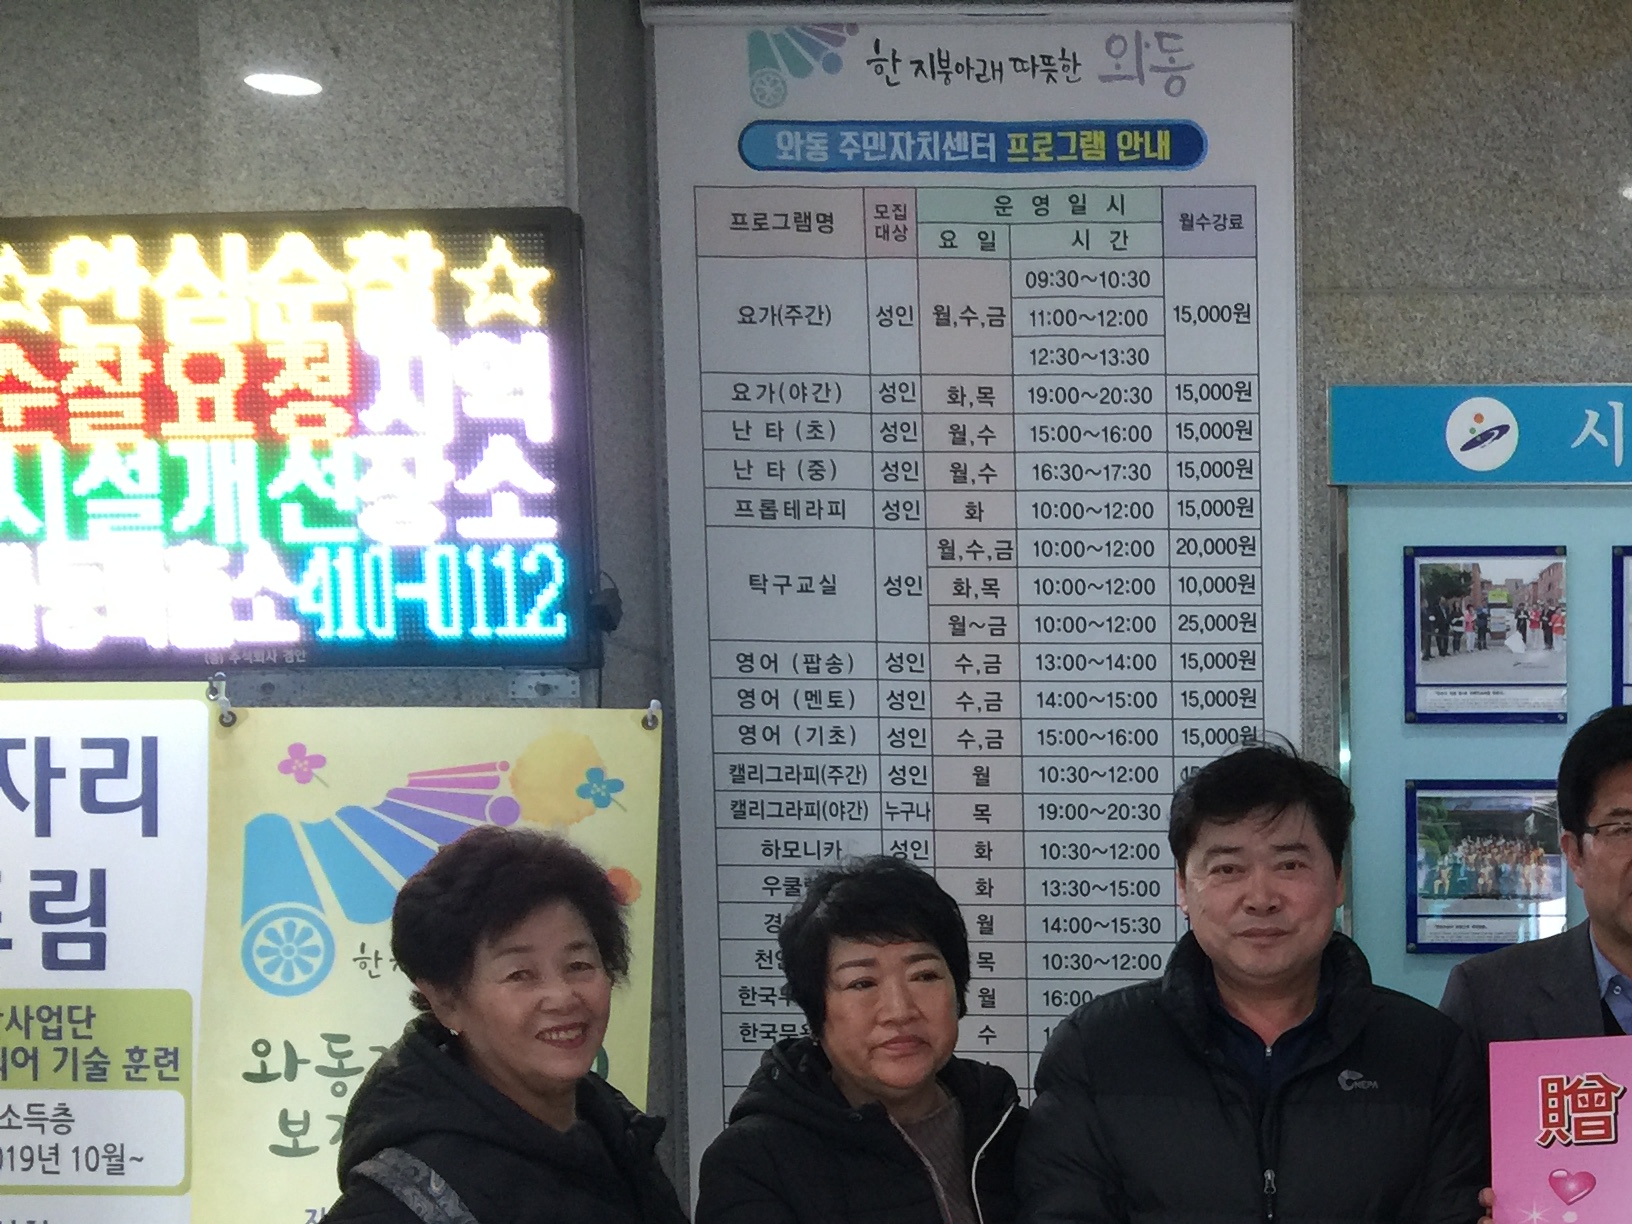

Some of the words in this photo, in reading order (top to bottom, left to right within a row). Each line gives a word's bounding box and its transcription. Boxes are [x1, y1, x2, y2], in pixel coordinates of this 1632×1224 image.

[865, 37, 903, 87] 한
[909, 55, 1004, 86] 지붕아래
[1008, 46, 1082, 85] 따뜻한
[776, 130, 829, 162] 와동
[839, 130, 996, 163] 주민자치센터
[1006, 129, 1106, 163] 프로그램
[1116, 129, 1171, 162] 안내
[729, 211, 834, 235] 프로그램명
[1178, 212, 1245, 232] 월수강료
[873, 203, 907, 222] 모집
[874, 223, 909, 243] 대상
[1025, 269, 1151, 289] 09:30~10:30
[737, 303, 832, 327] 요가(주간)
[875, 304, 914, 328] 성인
[932, 304, 1007, 329] 월,수,금
[1029, 308, 1148, 328] 11:00~12:00
[1173, 302, 1251, 326] 15,000원
[1029, 347, 1150, 367] 12:30~13:30
[731, 381, 842, 405] 요가(야간)
[878, 381, 917, 404] 성인
[946, 385, 996, 409] 화,목
[1027, 386, 1153, 405] 19:00~20:30
[1175, 380, 1253, 404] 15,000원
[879, 420, 918, 444] 성인
[947, 423, 997, 447] 월,수
[1030, 424, 1153, 444] 15:00~16:00
[1175, 419, 1253, 443] 15,000원
[949, 461, 998, 485] 월,수
[1032, 463, 1152, 482] 16:30~17:30
[1176, 457, 1254, 482] 15,000원
[733, 498, 846, 521] 프롭테라피
[964, 500, 985, 523] 화
[1031, 501, 1154, 520] 10:00~12:00
[1177, 496, 1254, 520] 15,000원
[937, 538, 1014, 562] 월,수,금
[1033, 539, 1155, 559] 10:00~12:00
[1175, 535, 1256, 558] 20,000원
[748, 573, 837, 596] 탁구교실
[883, 575, 923, 597] 성인
[952, 577, 1001, 600] 화,목
[1033, 577, 1156, 596] 10:00~12:00
[1178, 573, 1256, 597] 10,000원
[948, 614, 1008, 637] 월~금
[1034, 615, 1157, 634] 10:00~12:00
[1177, 611, 1257, 635] 25,000원
[735, 652, 778, 674] 영어
[792, 652, 854, 675] (팝송)
[954, 653, 1003, 676] 수,금
[1035, 653, 1157, 672] 13:00~14:00
[737, 688, 779, 710] 영어
[793, 688, 855, 711] (멘토)
[955, 690, 1004, 713] 수,금
[1036, 691, 1158, 709] 14:00~15:00
[738, 724, 781, 746] 영어
[794, 724, 856, 747] (기초)
[956, 728, 1004, 751] 수,금
[1037, 728, 1159, 747] 15:00~16:00
[728, 762, 868, 786] 캘리그라피(주간)
[972, 765, 990, 787] 월
[1038, 765, 1159, 784] 10:30~12:00
[730, 798, 869, 822] 캘리그라피(야간)
[884, 801, 932, 823] 누구나
[972, 803, 992, 825] 목
[1037, 802, 1161, 821] 19:00~20:30
[760, 838, 843, 861] 하모니카
[973, 840, 994, 862] 화
[1040, 842, 1161, 861] 10:30~12:00
[1041, 879, 1161, 898] 13:30~15:00
[1042, 916, 1161, 935] 14:00~15:30
[1042, 953, 1162, 971] 10:30~12:00
[52, 1046, 111, 1083] 기술
[121, 1045, 180, 1083] 훈련
[1536, 1073, 1623, 1148] 贈
[71, 1142, 144, 1176] 10월~
